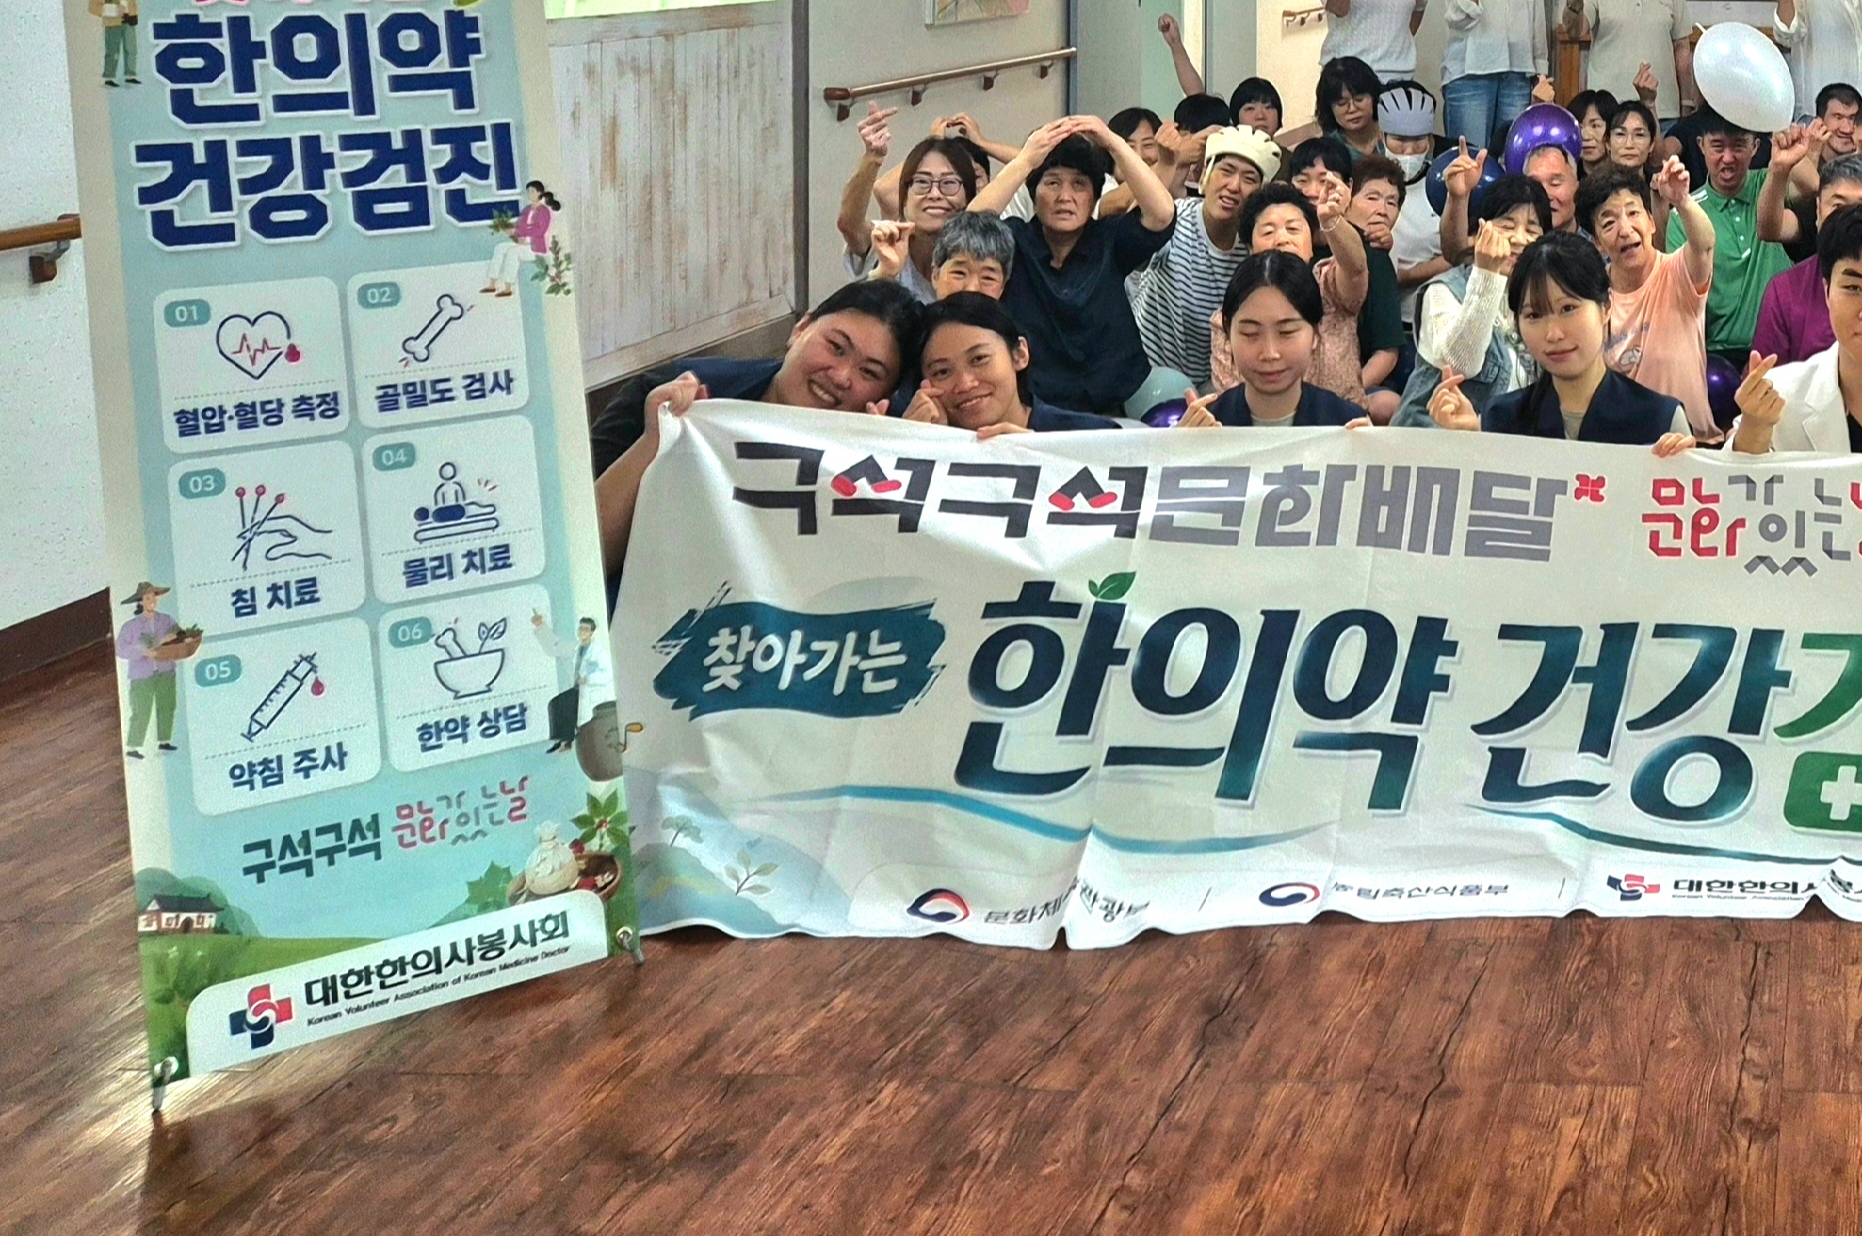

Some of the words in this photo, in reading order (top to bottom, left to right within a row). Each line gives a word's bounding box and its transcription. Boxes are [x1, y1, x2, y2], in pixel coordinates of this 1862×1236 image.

[153, 10, 481, 124] 한의약
[135, 123, 522, 246] 건강검진
[174, 305, 200, 322] 01
[368, 288, 391, 303] 02
[290, 392, 340, 421] 측정
[375, 377, 454, 409] 골밀도
[459, 372, 514, 399] 검사
[382, 449, 408, 464] 04
[190, 476, 214, 492] 03
[732, 441, 1568, 561] 구석구석문화배달
[403, 553, 457, 585] 물리
[462, 545, 513, 575] 치료
[231, 585, 260, 616] 침
[268, 578, 321, 609] 치료
[399, 625, 422, 640] 06
[205, 663, 231, 680] 05
[703, 627, 908, 696] 찾아가는
[954, 581, 1458, 809] 한의약
[417, 715, 470, 750] 한약
[477, 704, 527, 738] 상담
[229, 755, 285, 792] 약침
[290, 744, 347, 781] 주사
[242, 814, 382, 882] 구석구석
[985, 876, 1149, 924] 문화체관광부
[305, 910, 570, 1007] 대한한의사봉사회
[308, 1011, 342, 1026] Korean
[346, 998, 390, 1015] Volunteer
[394, 981, 449, 1002] Association
[452, 976, 461, 985] of
[464, 967, 496, 982] Korean
[499, 955, 538, 970] Medicine
[541, 945, 570, 960] Doctor
